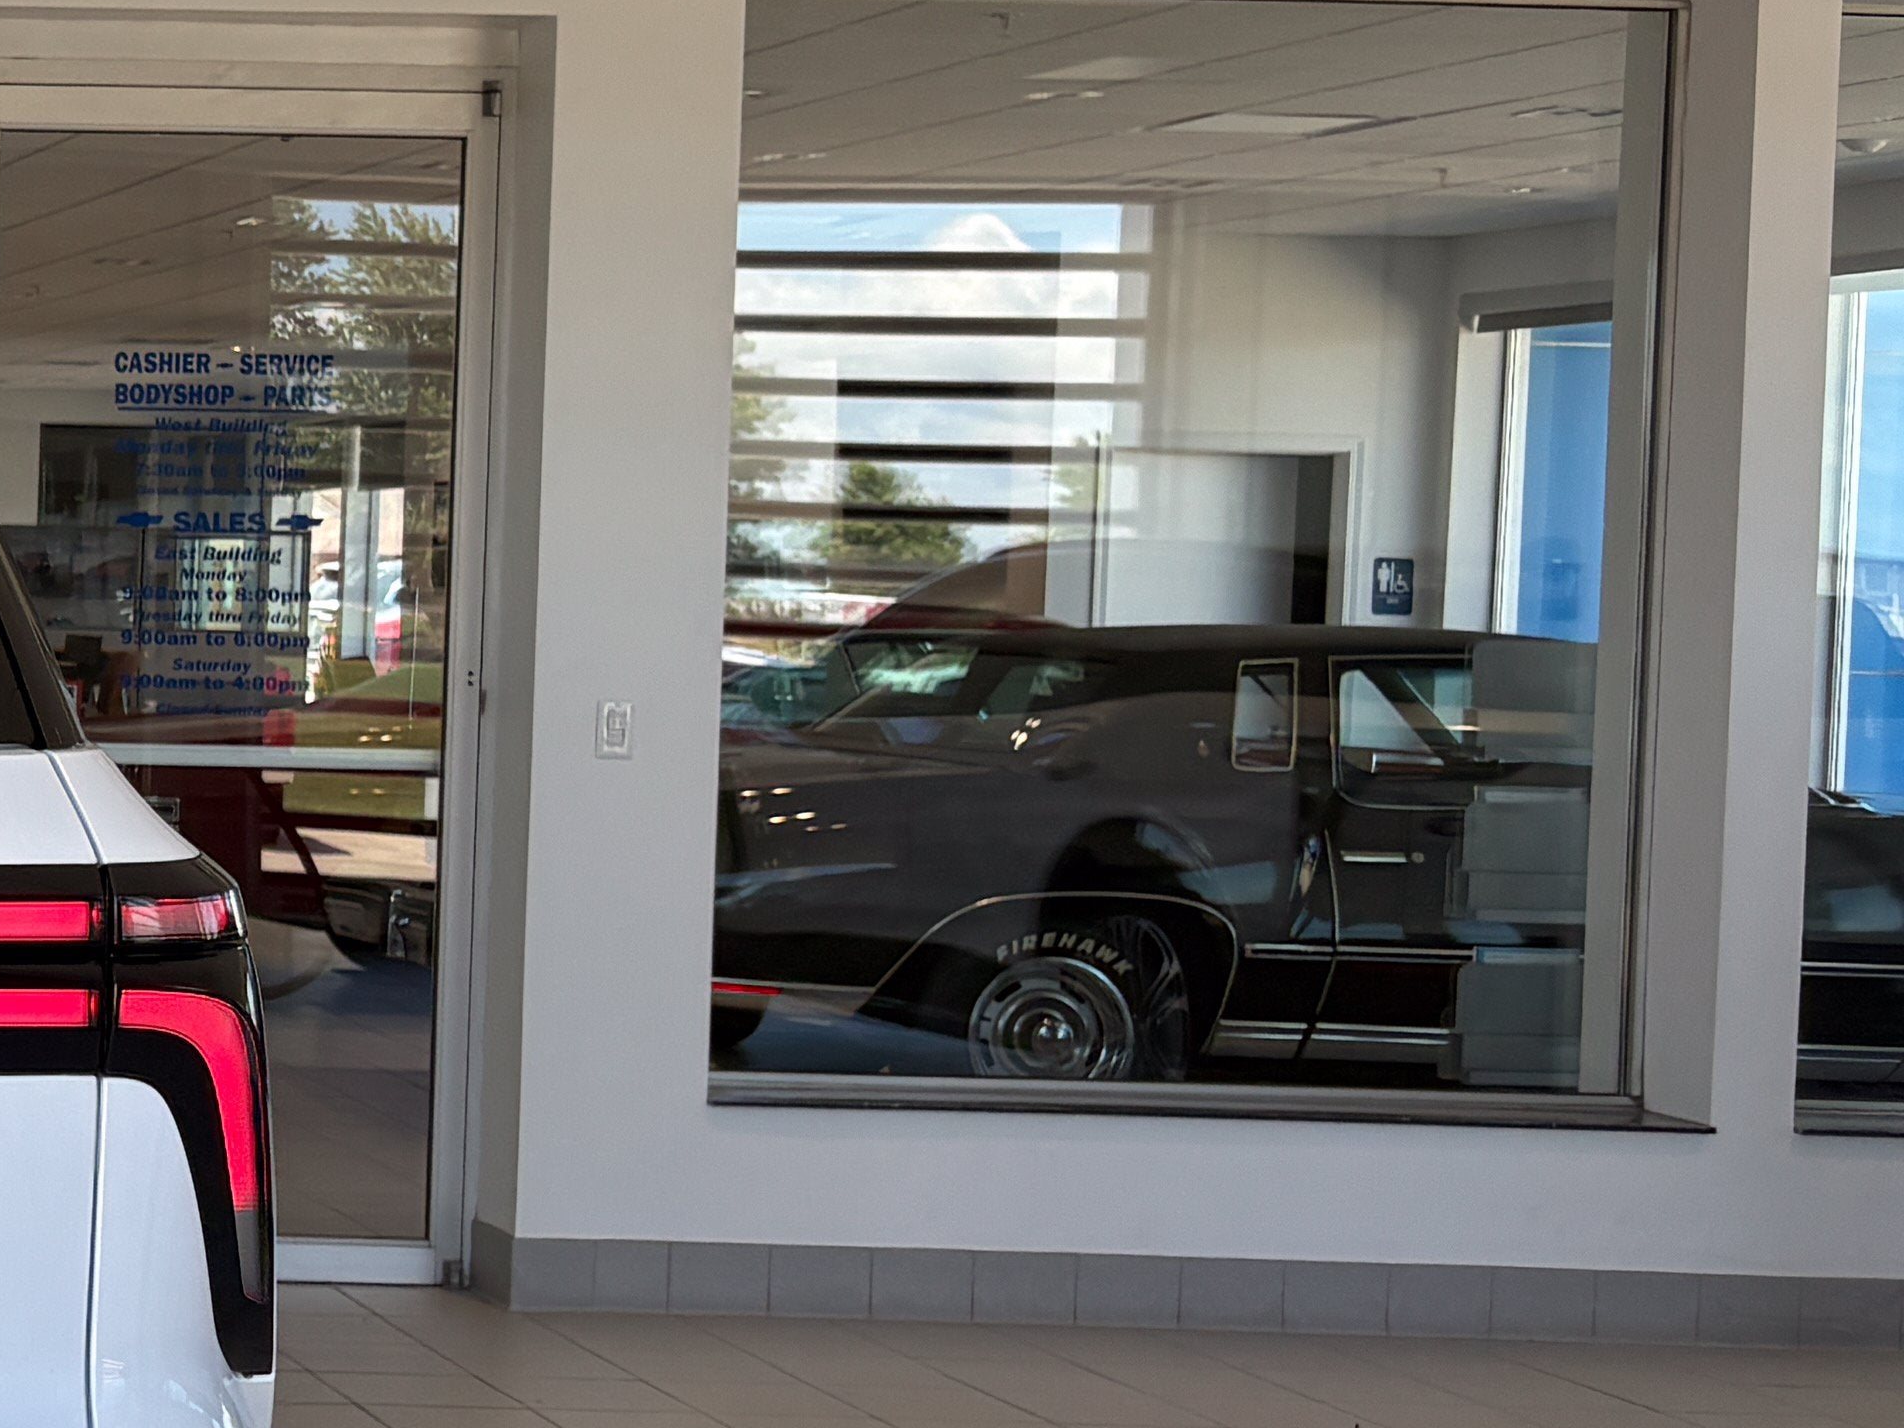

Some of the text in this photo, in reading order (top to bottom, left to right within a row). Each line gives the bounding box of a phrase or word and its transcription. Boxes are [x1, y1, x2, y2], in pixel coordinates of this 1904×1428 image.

[114, 351, 335, 375] CASHIER SERVICE
[114, 383, 333, 407] BODYSHOP PARTS
[173, 511, 268, 533] SALES
[155, 545, 283, 566] East Building
[181, 567, 248, 584] Monday
[206, 586, 228, 602] to
[234, 586, 312, 605] 8:00pm
[208, 609, 243, 624] thru
[120, 629, 198, 647] 9:00am
[205, 630, 226, 647] to
[173, 657, 252, 675] Saturday
[203, 675, 226, 691] to
[995, 930, 1135, 977] FIREHAWK
